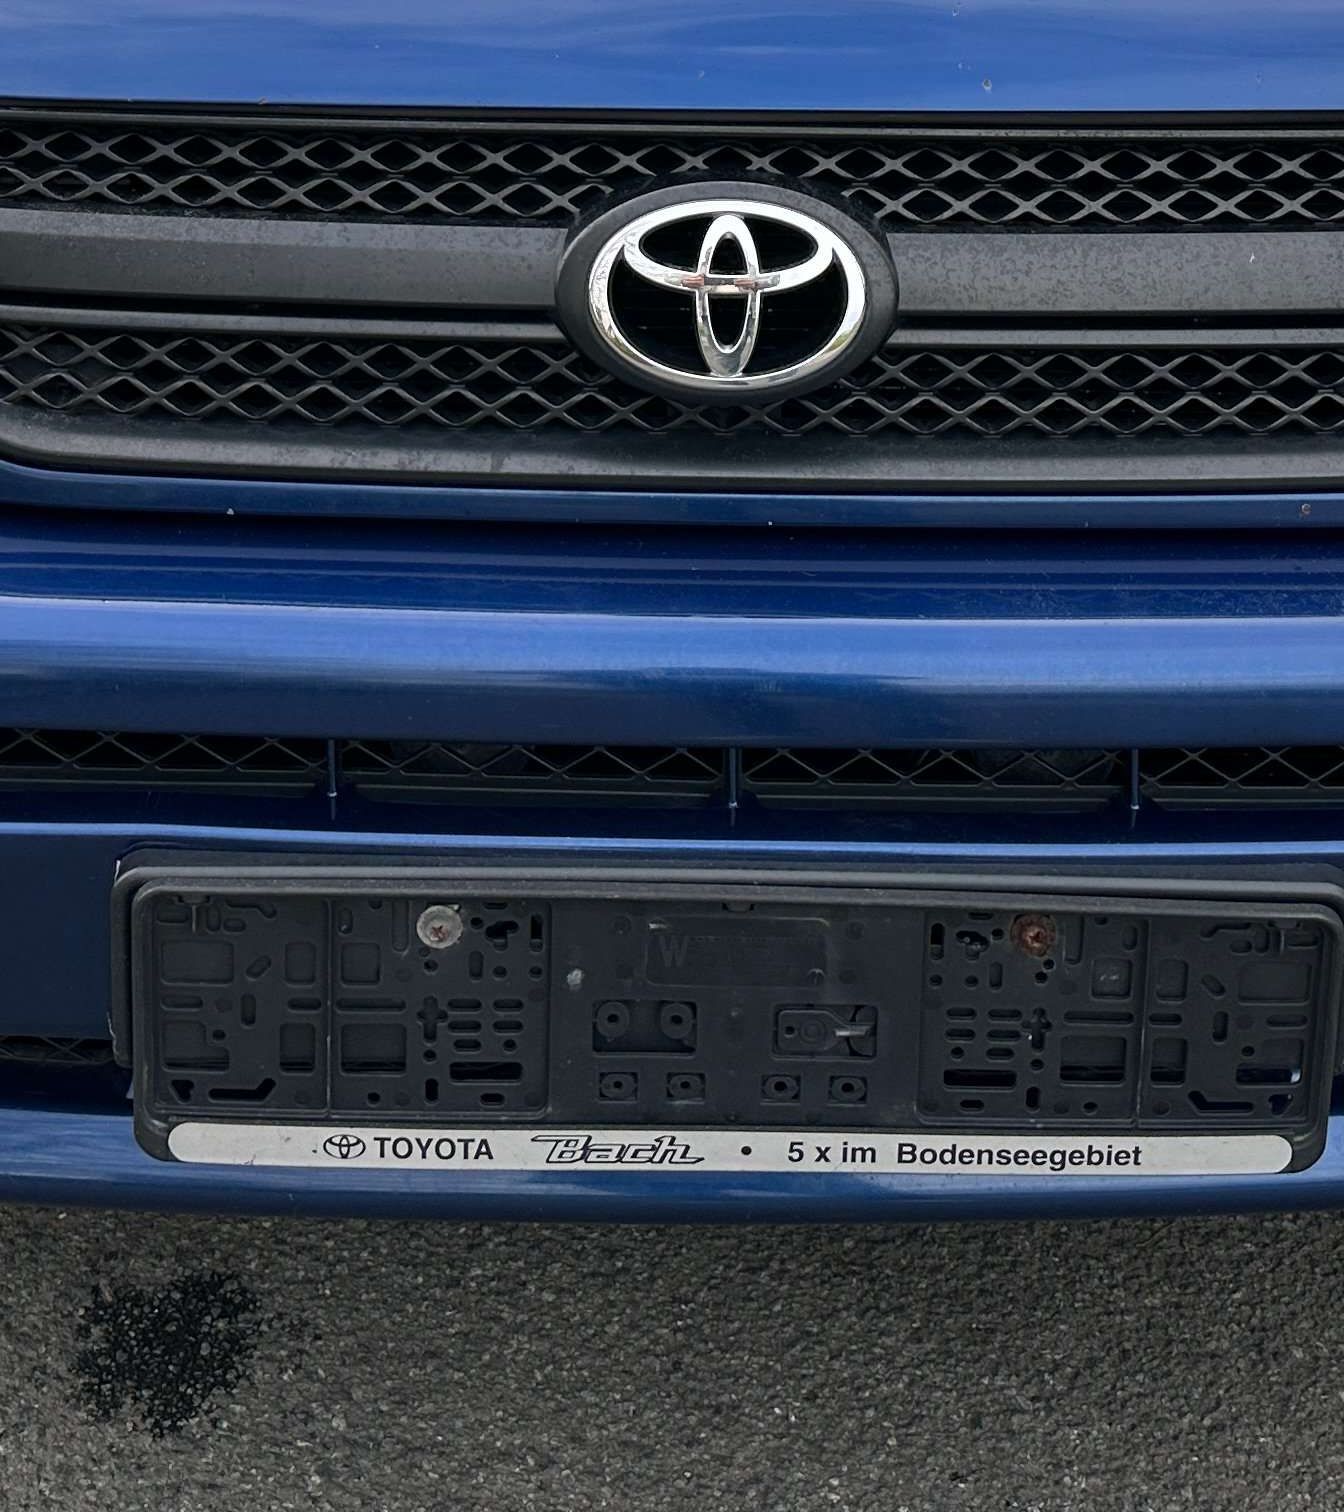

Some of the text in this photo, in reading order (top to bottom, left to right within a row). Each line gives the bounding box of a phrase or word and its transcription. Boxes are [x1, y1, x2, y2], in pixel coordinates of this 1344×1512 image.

[373, 1134, 1143, 1172] TOYOTA Bach 5 x im Bodenseegebiet
